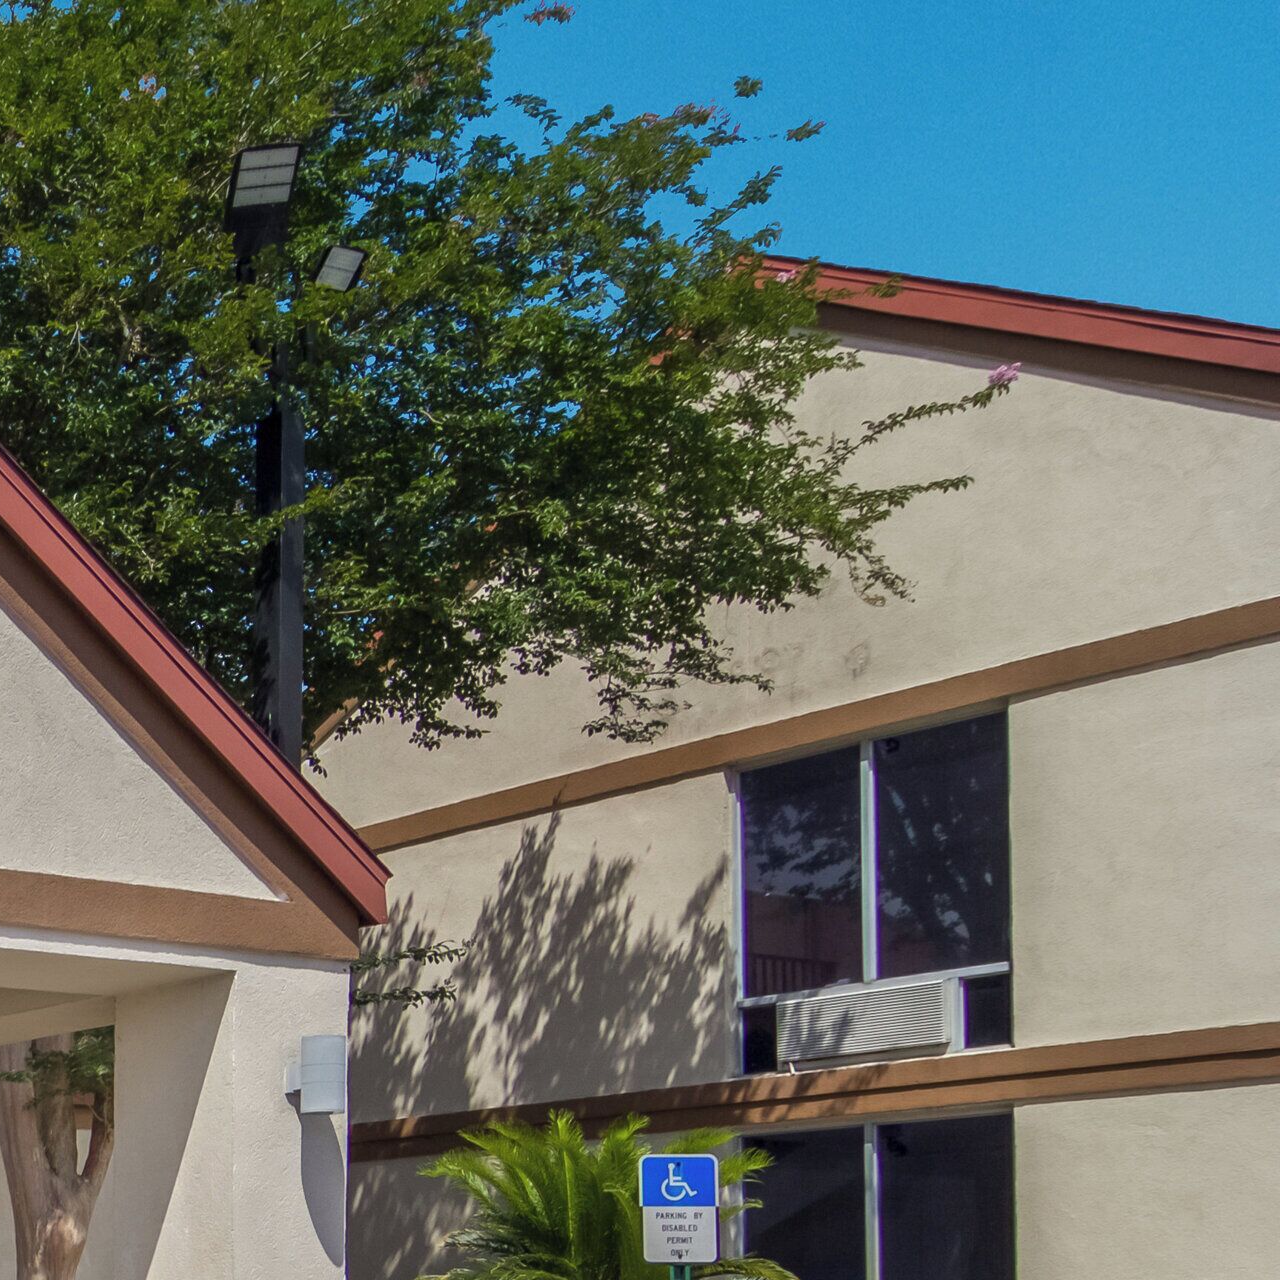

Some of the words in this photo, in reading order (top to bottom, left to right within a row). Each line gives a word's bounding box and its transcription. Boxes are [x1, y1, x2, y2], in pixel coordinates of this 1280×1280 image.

[655, 1212, 687, 1220] PARKING
[693, 1212, 704, 1220] BY
[661, 1224, 698, 1232] DISABLED
[666, 1236, 693, 1244] PERMIT
[670, 1249, 689, 1257] ONLY
